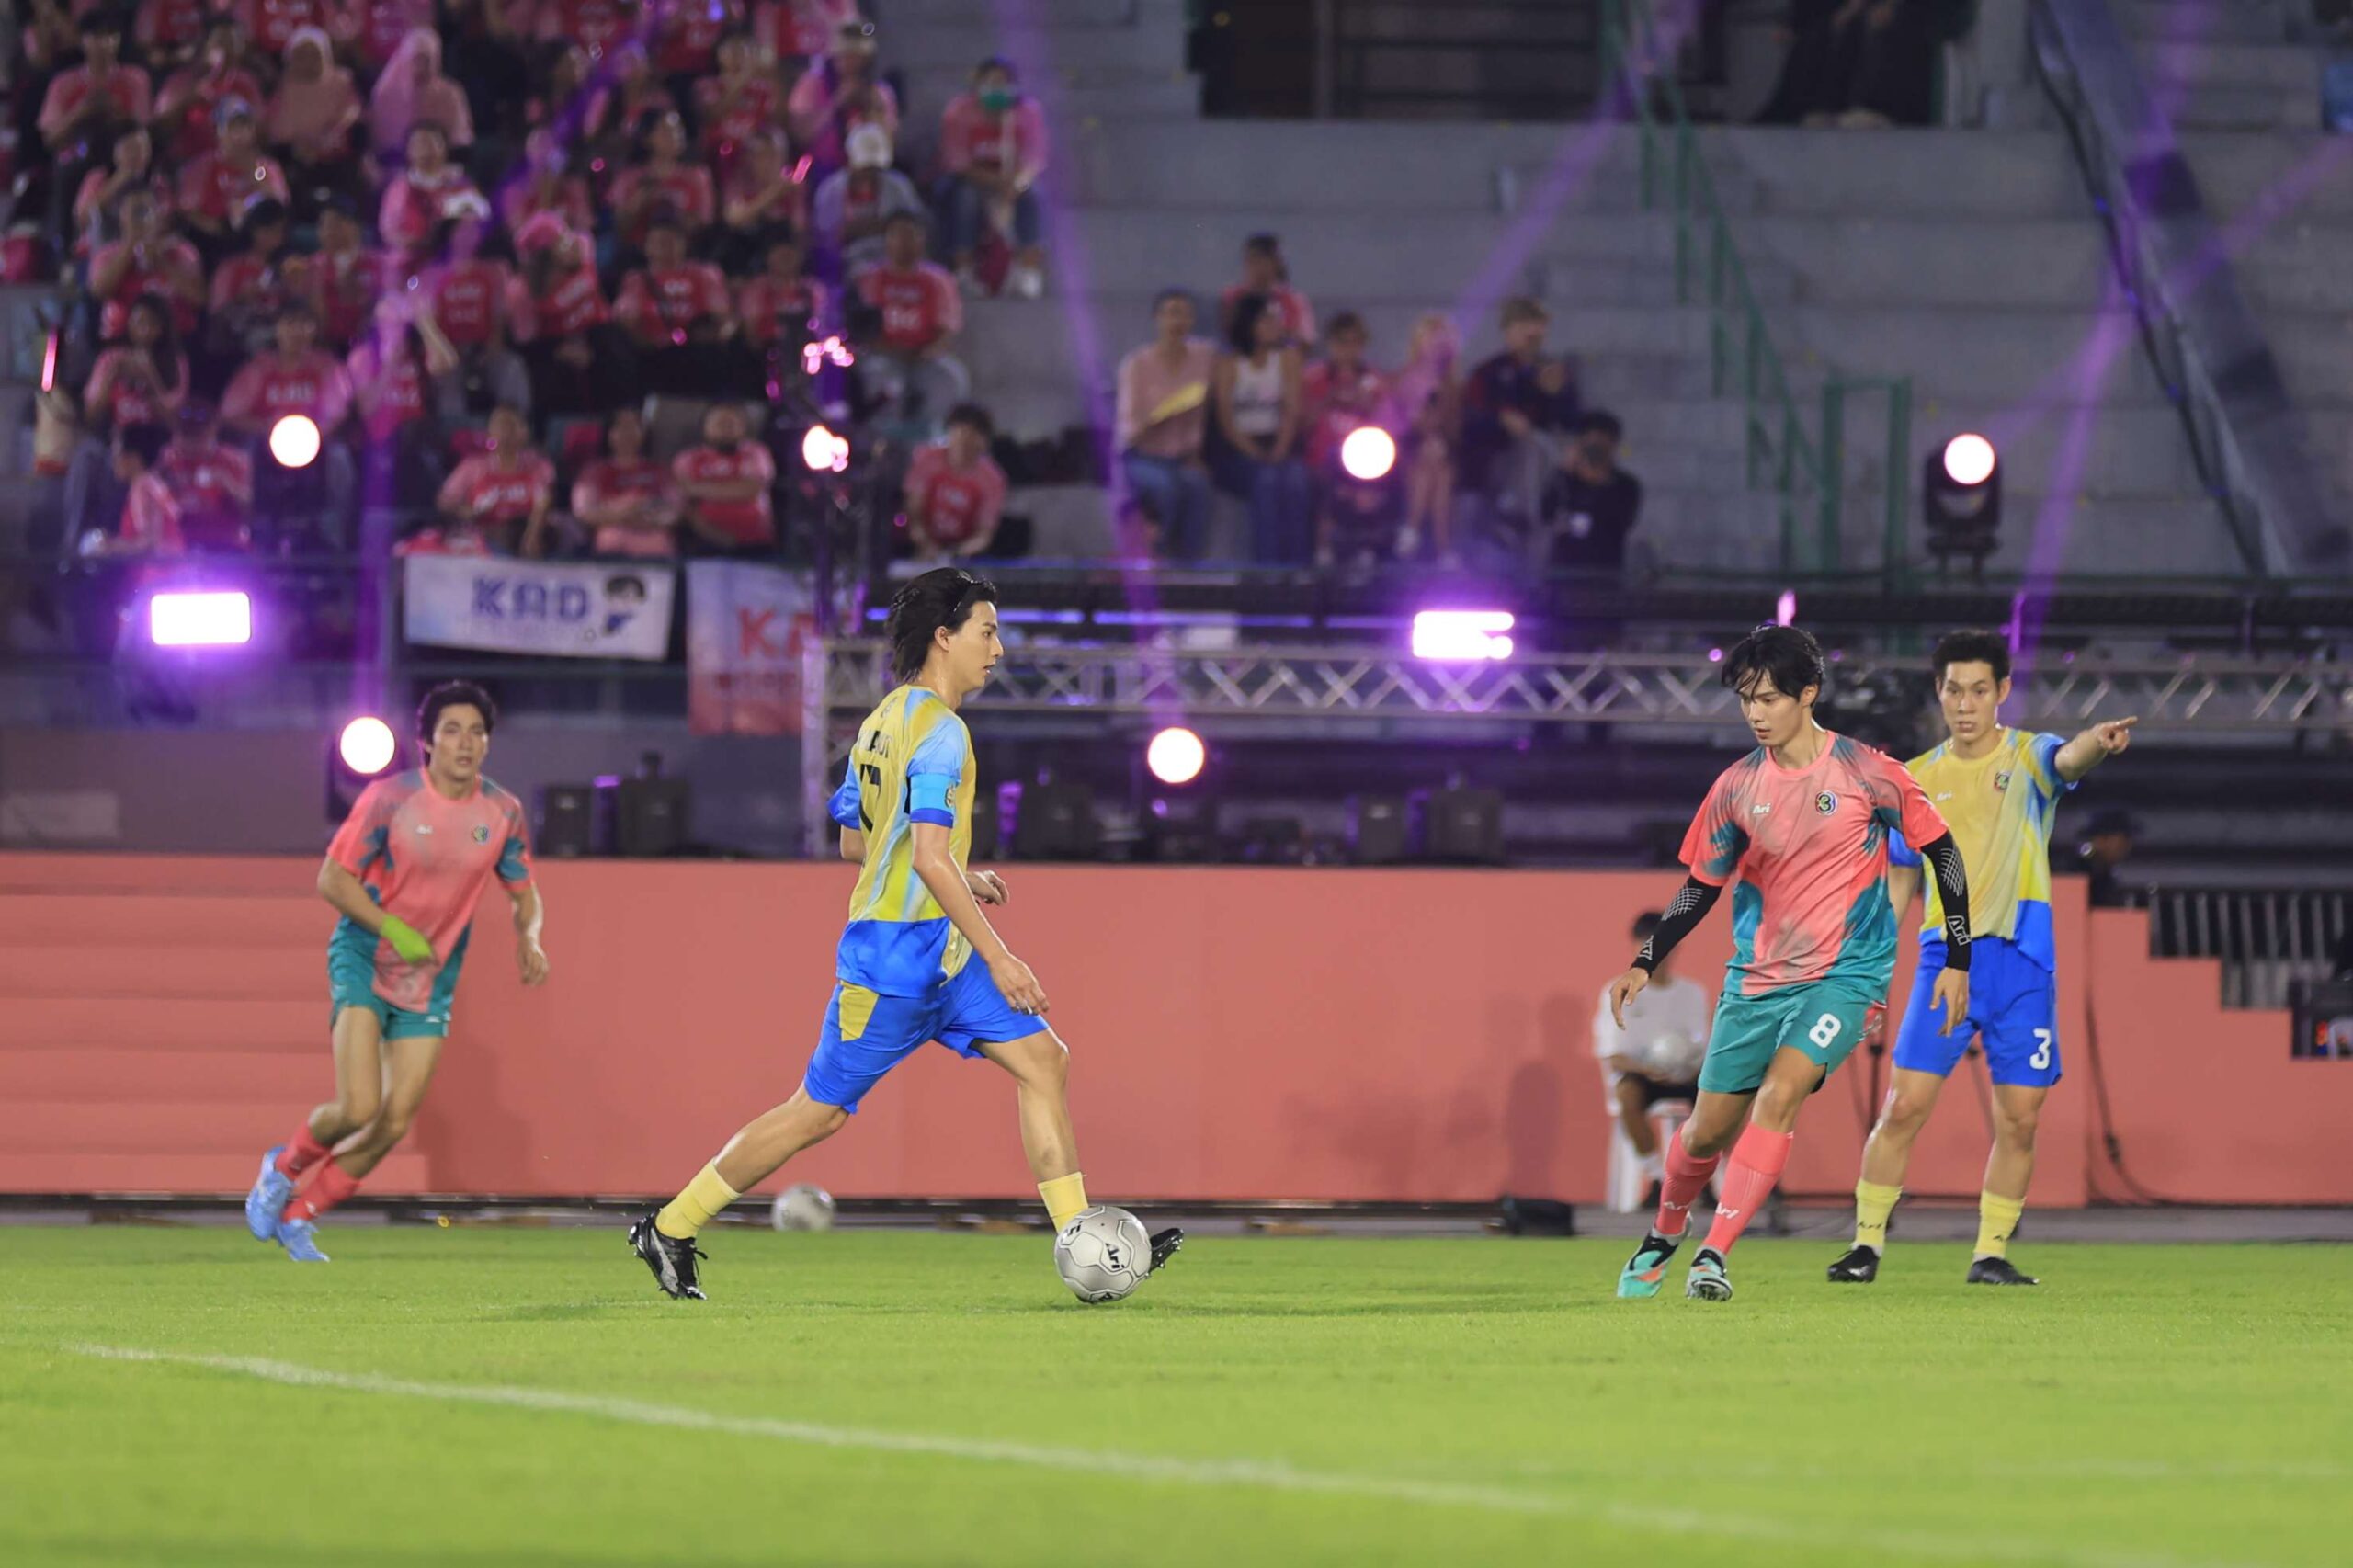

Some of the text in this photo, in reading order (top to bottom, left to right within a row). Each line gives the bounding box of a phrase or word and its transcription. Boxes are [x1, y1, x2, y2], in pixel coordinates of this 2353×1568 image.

[1947, 915, 1972, 946] Ari
[1808, 1013, 1842, 1049] 8
[2029, 1028, 2052, 1070] 3
